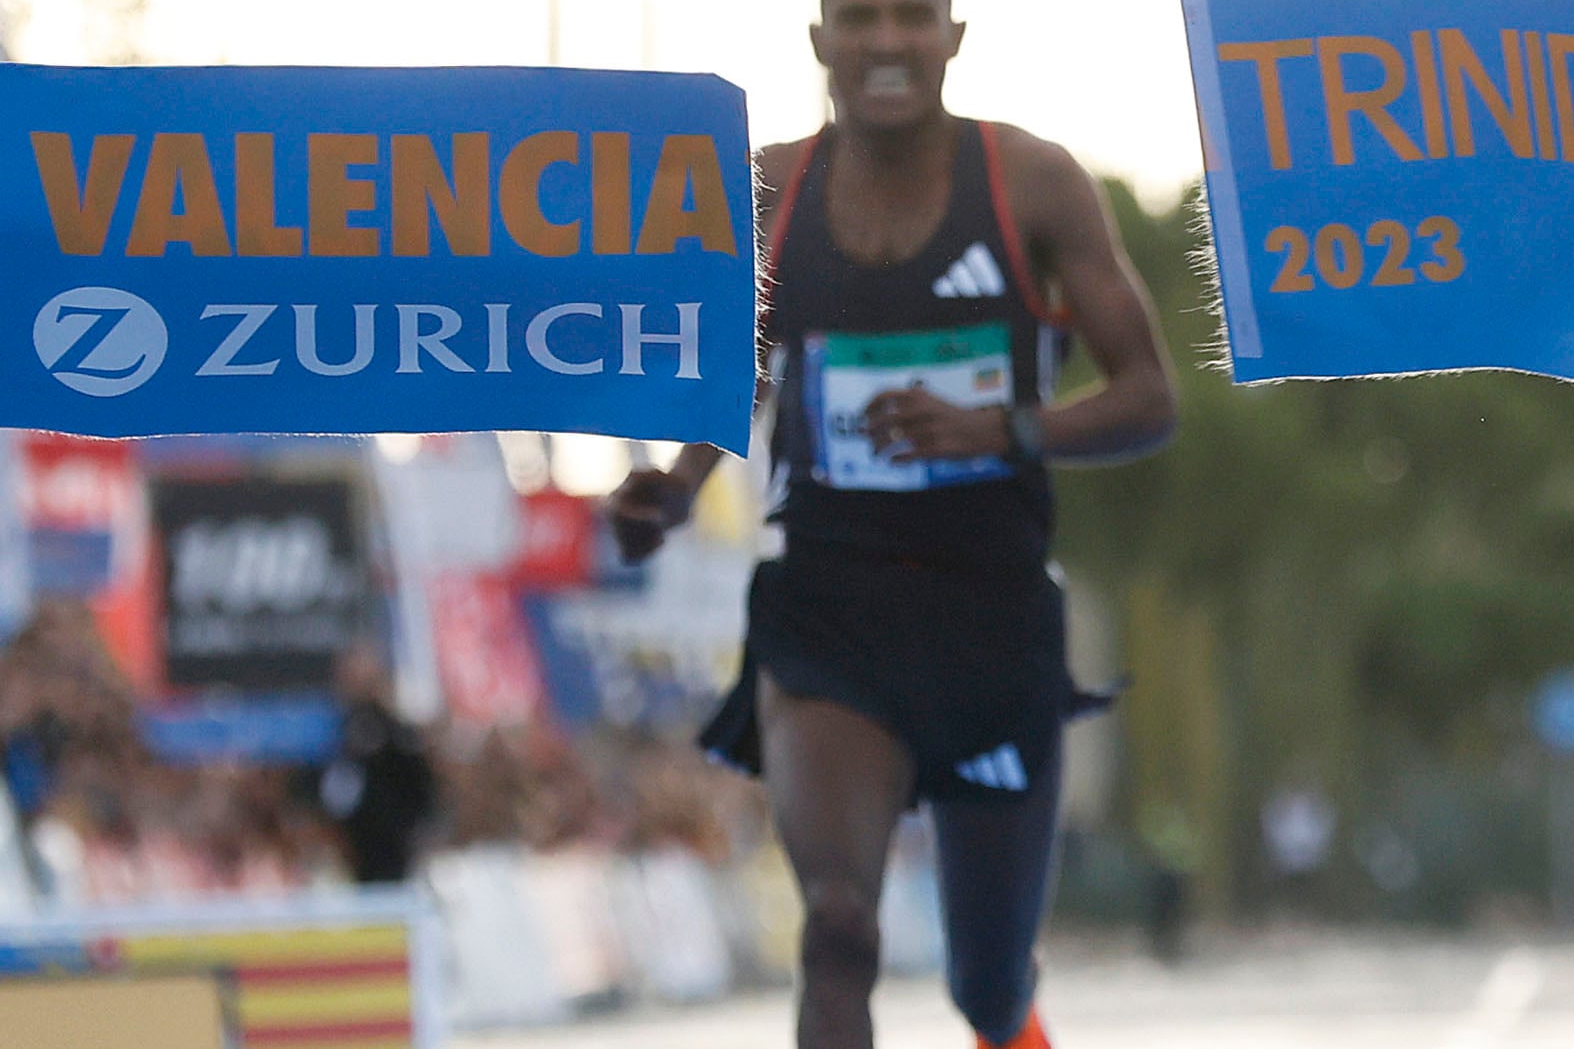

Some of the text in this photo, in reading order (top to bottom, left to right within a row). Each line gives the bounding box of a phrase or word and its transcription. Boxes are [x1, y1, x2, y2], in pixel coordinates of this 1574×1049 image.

[30, 130, 738, 257] VALENCIA
[1265, 215, 1466, 293] 2023
[195, 302, 703, 379] ZURICH
